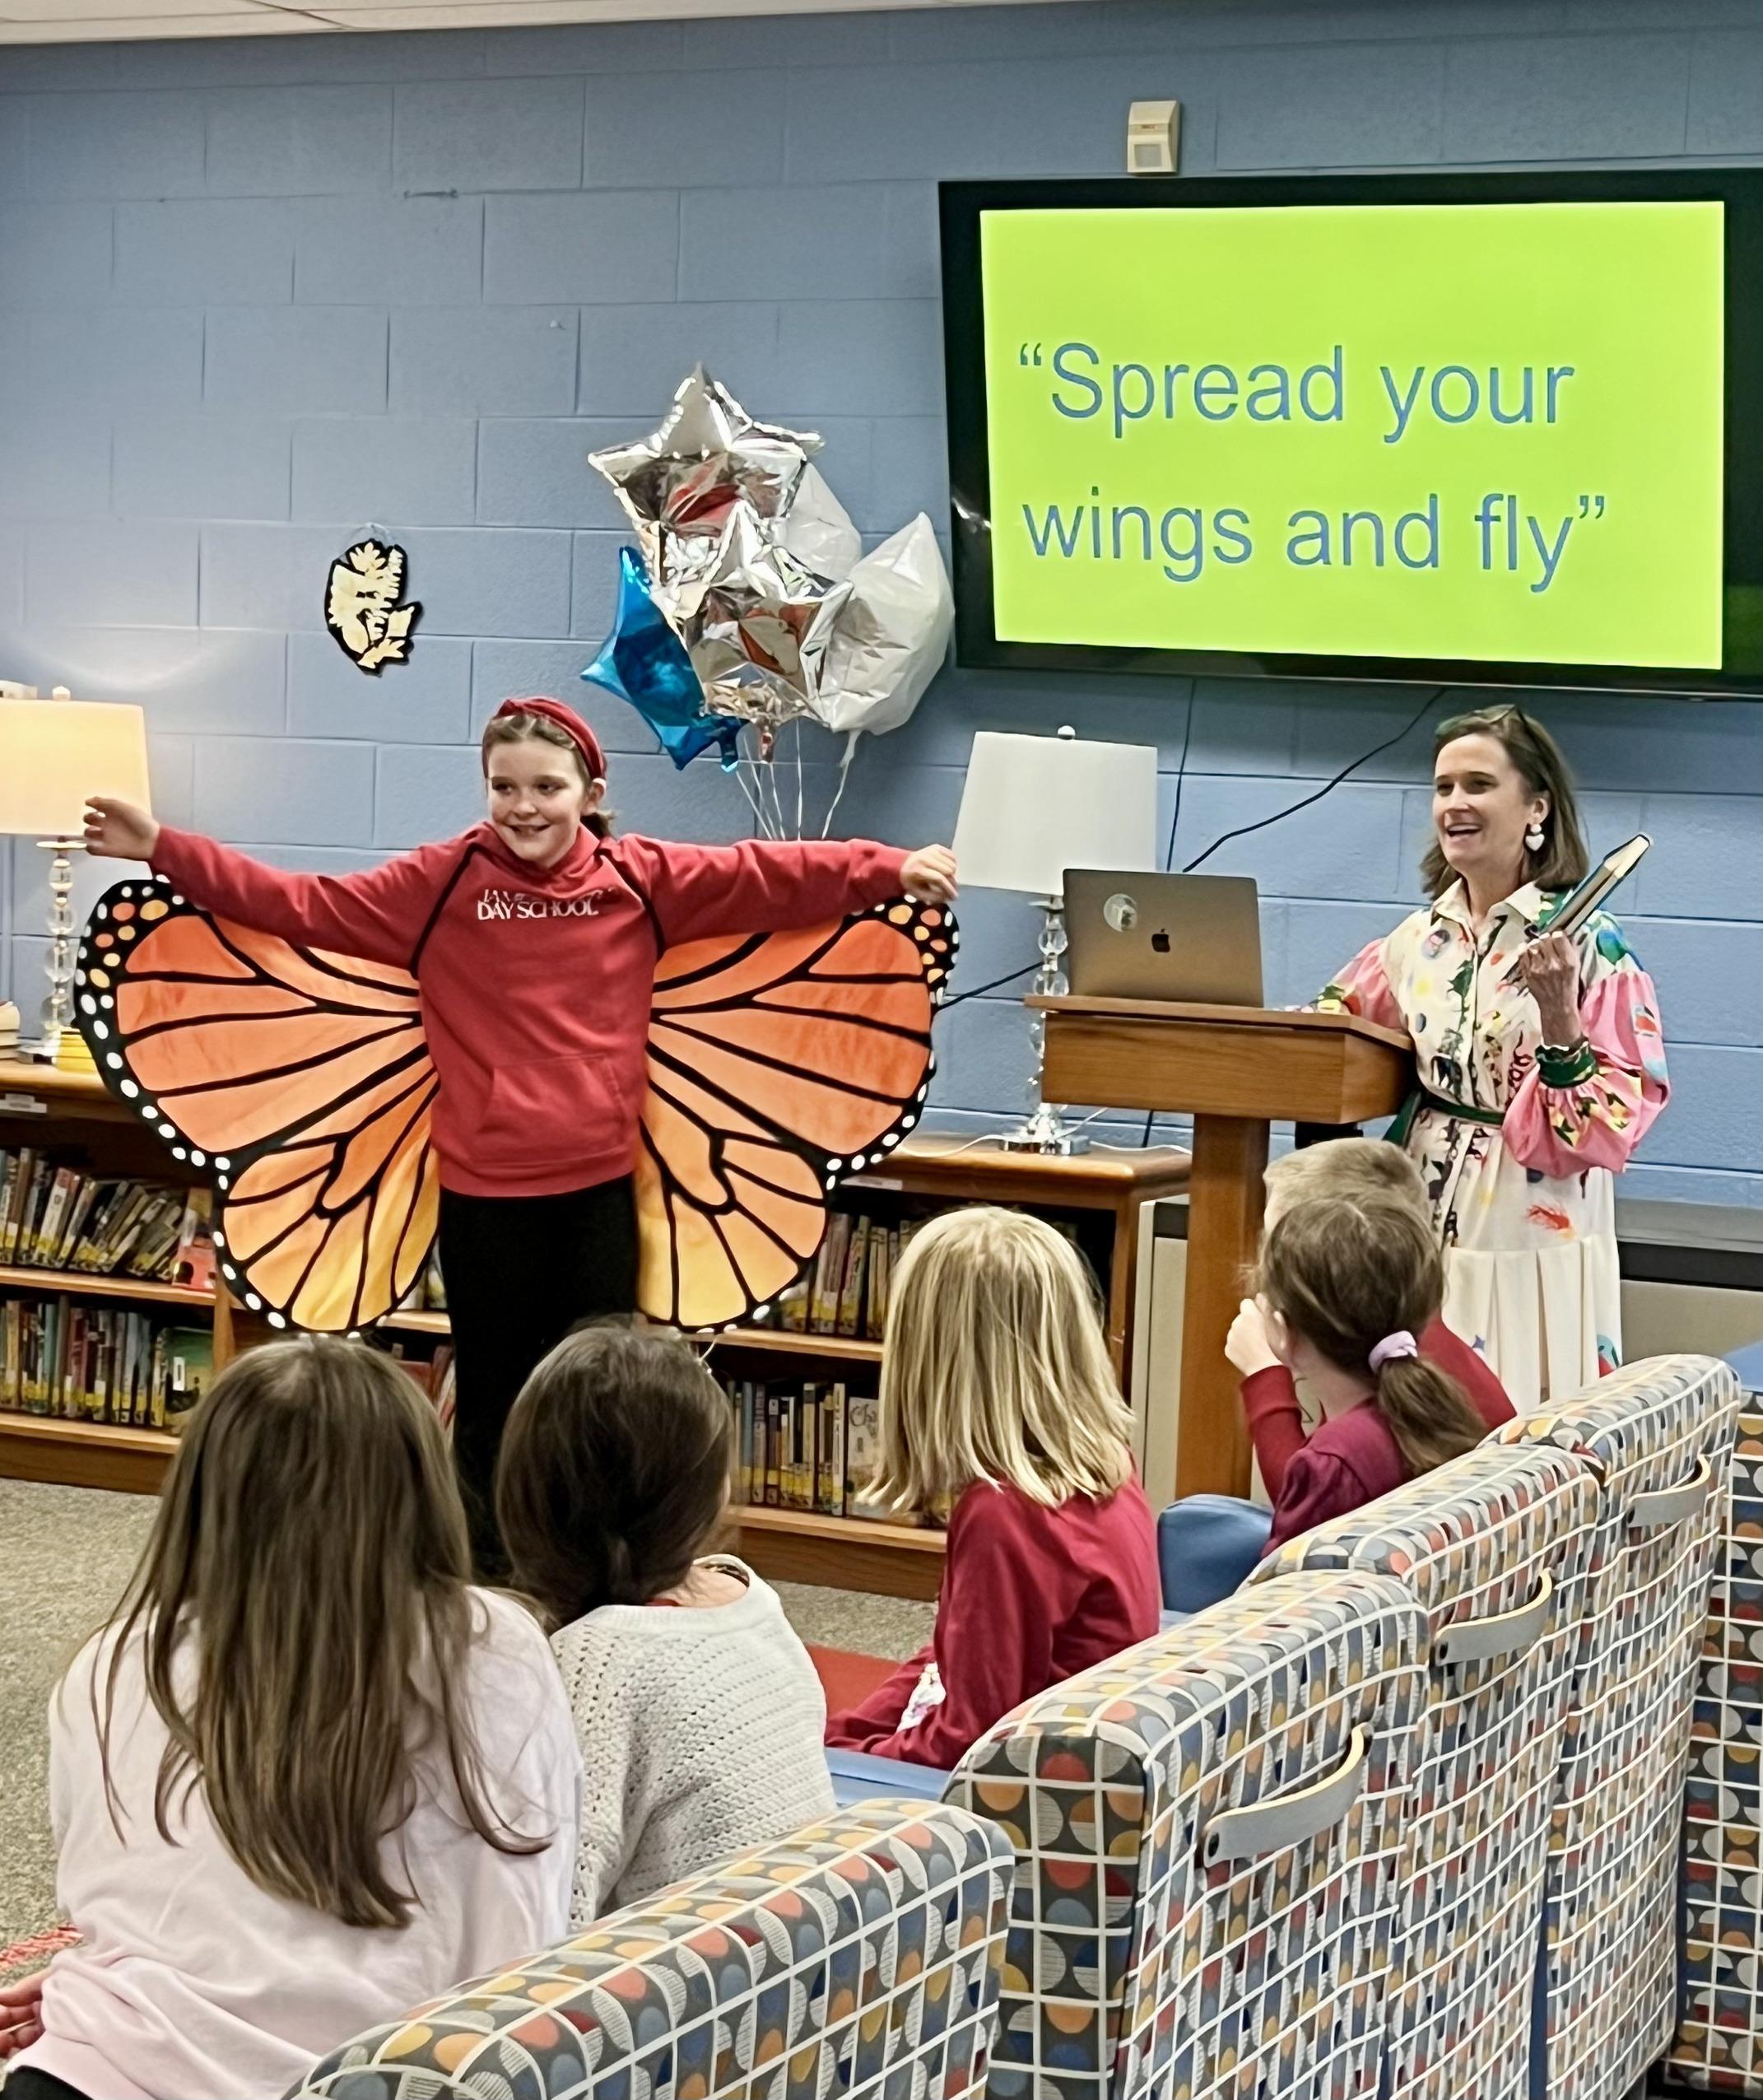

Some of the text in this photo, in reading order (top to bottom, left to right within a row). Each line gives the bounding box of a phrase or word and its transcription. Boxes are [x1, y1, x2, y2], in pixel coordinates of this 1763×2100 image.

[1021, 342, 1575, 445] “Spread your
[1022, 486, 1605, 594] wings and fly”
[477, 901, 514, 920] DAY
